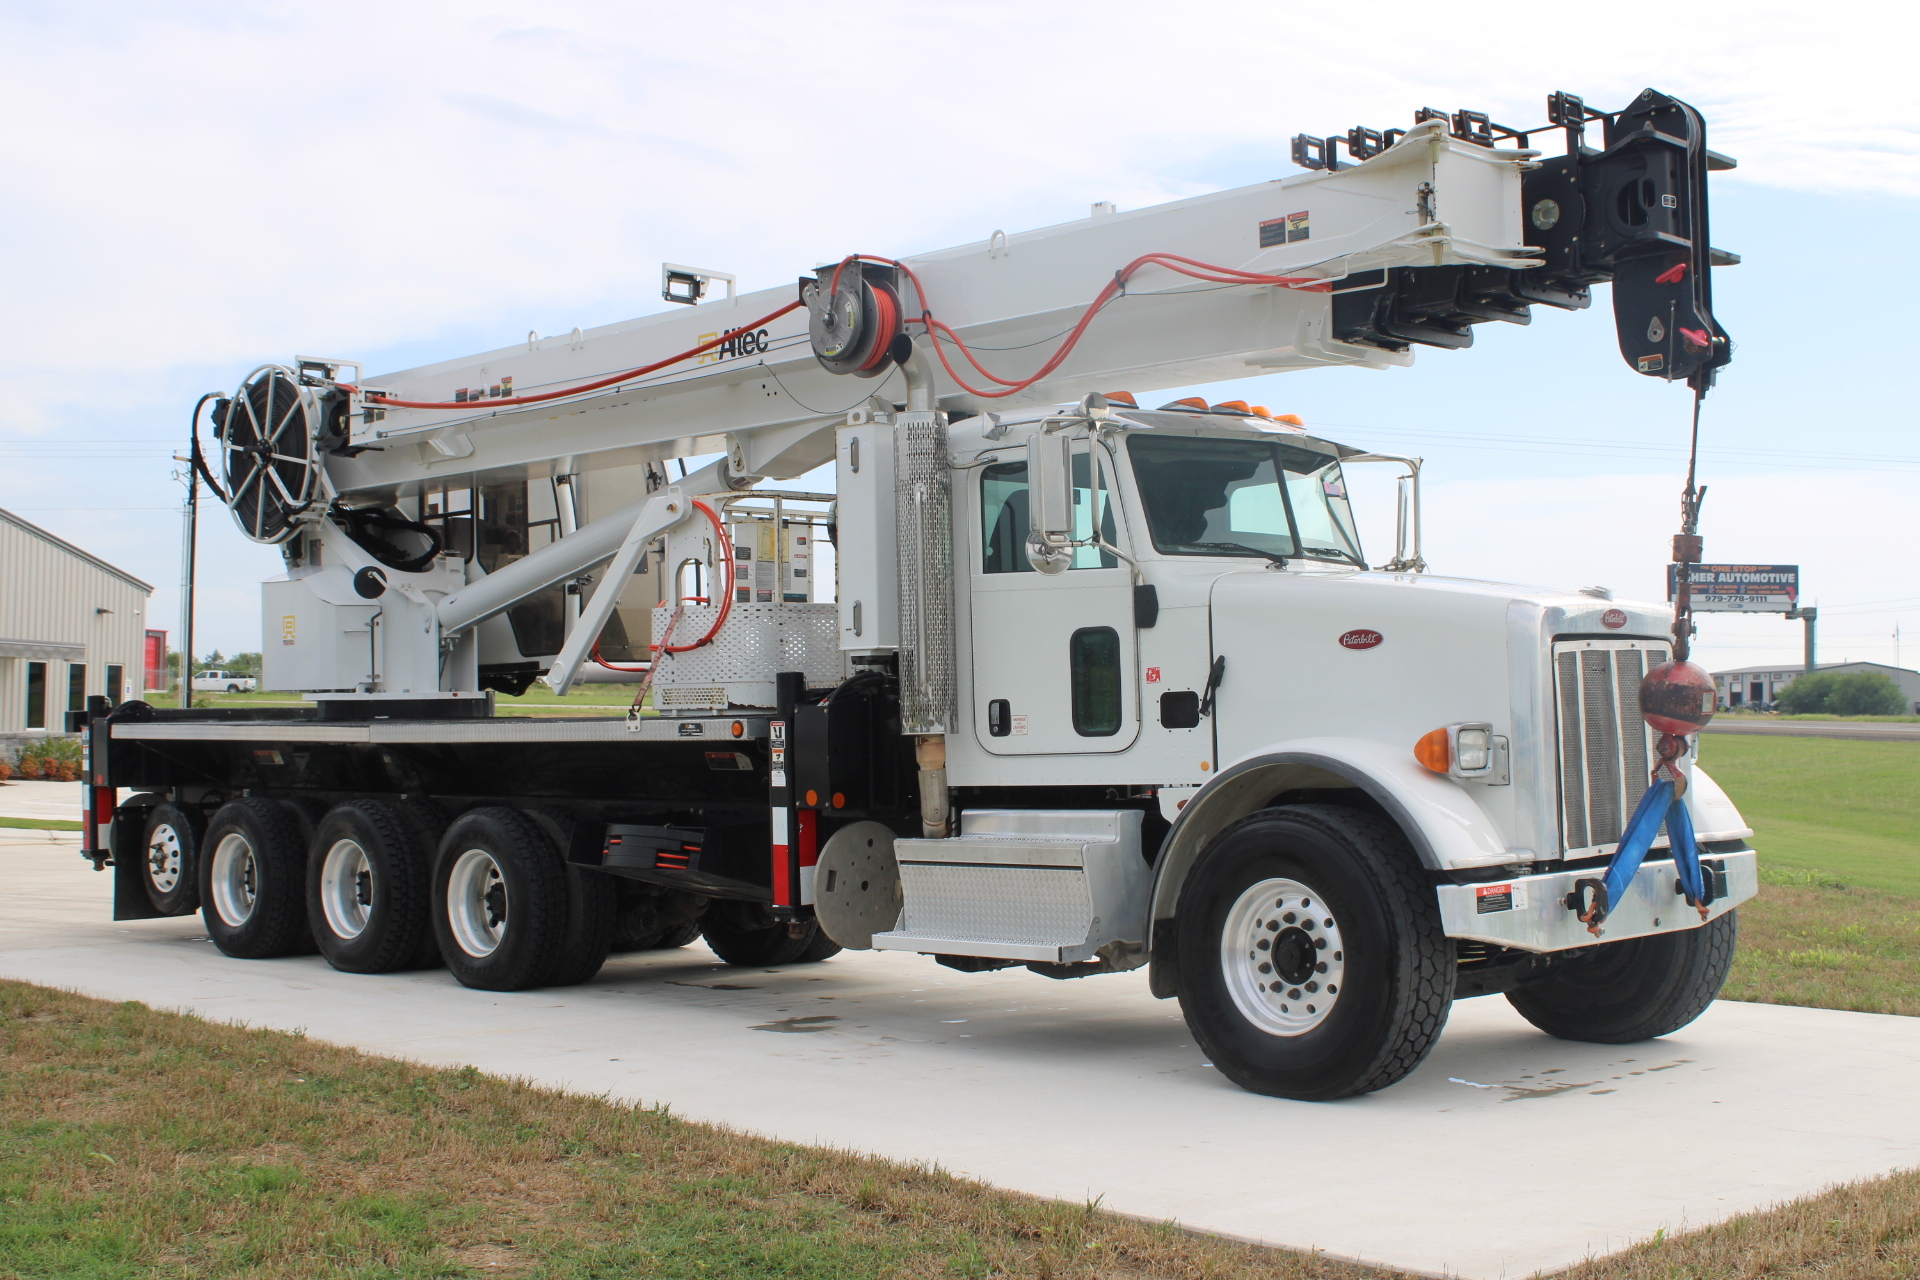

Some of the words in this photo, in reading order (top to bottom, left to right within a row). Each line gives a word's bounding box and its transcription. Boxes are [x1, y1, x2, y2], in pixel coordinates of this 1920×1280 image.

[718, 326, 769, 361] Altec
[1711, 565, 1731, 573] ONE
[1732, 565, 1758, 573] STOP
[1675, 572, 1715, 582] HER
[1718, 572, 1795, 582] AUTOMOTIVE
[1704, 595, 1768, 603] 979-778-9111
[1343, 633, 1379, 646] Peterbilt
[1487, 886, 1506, 894] DANGER
